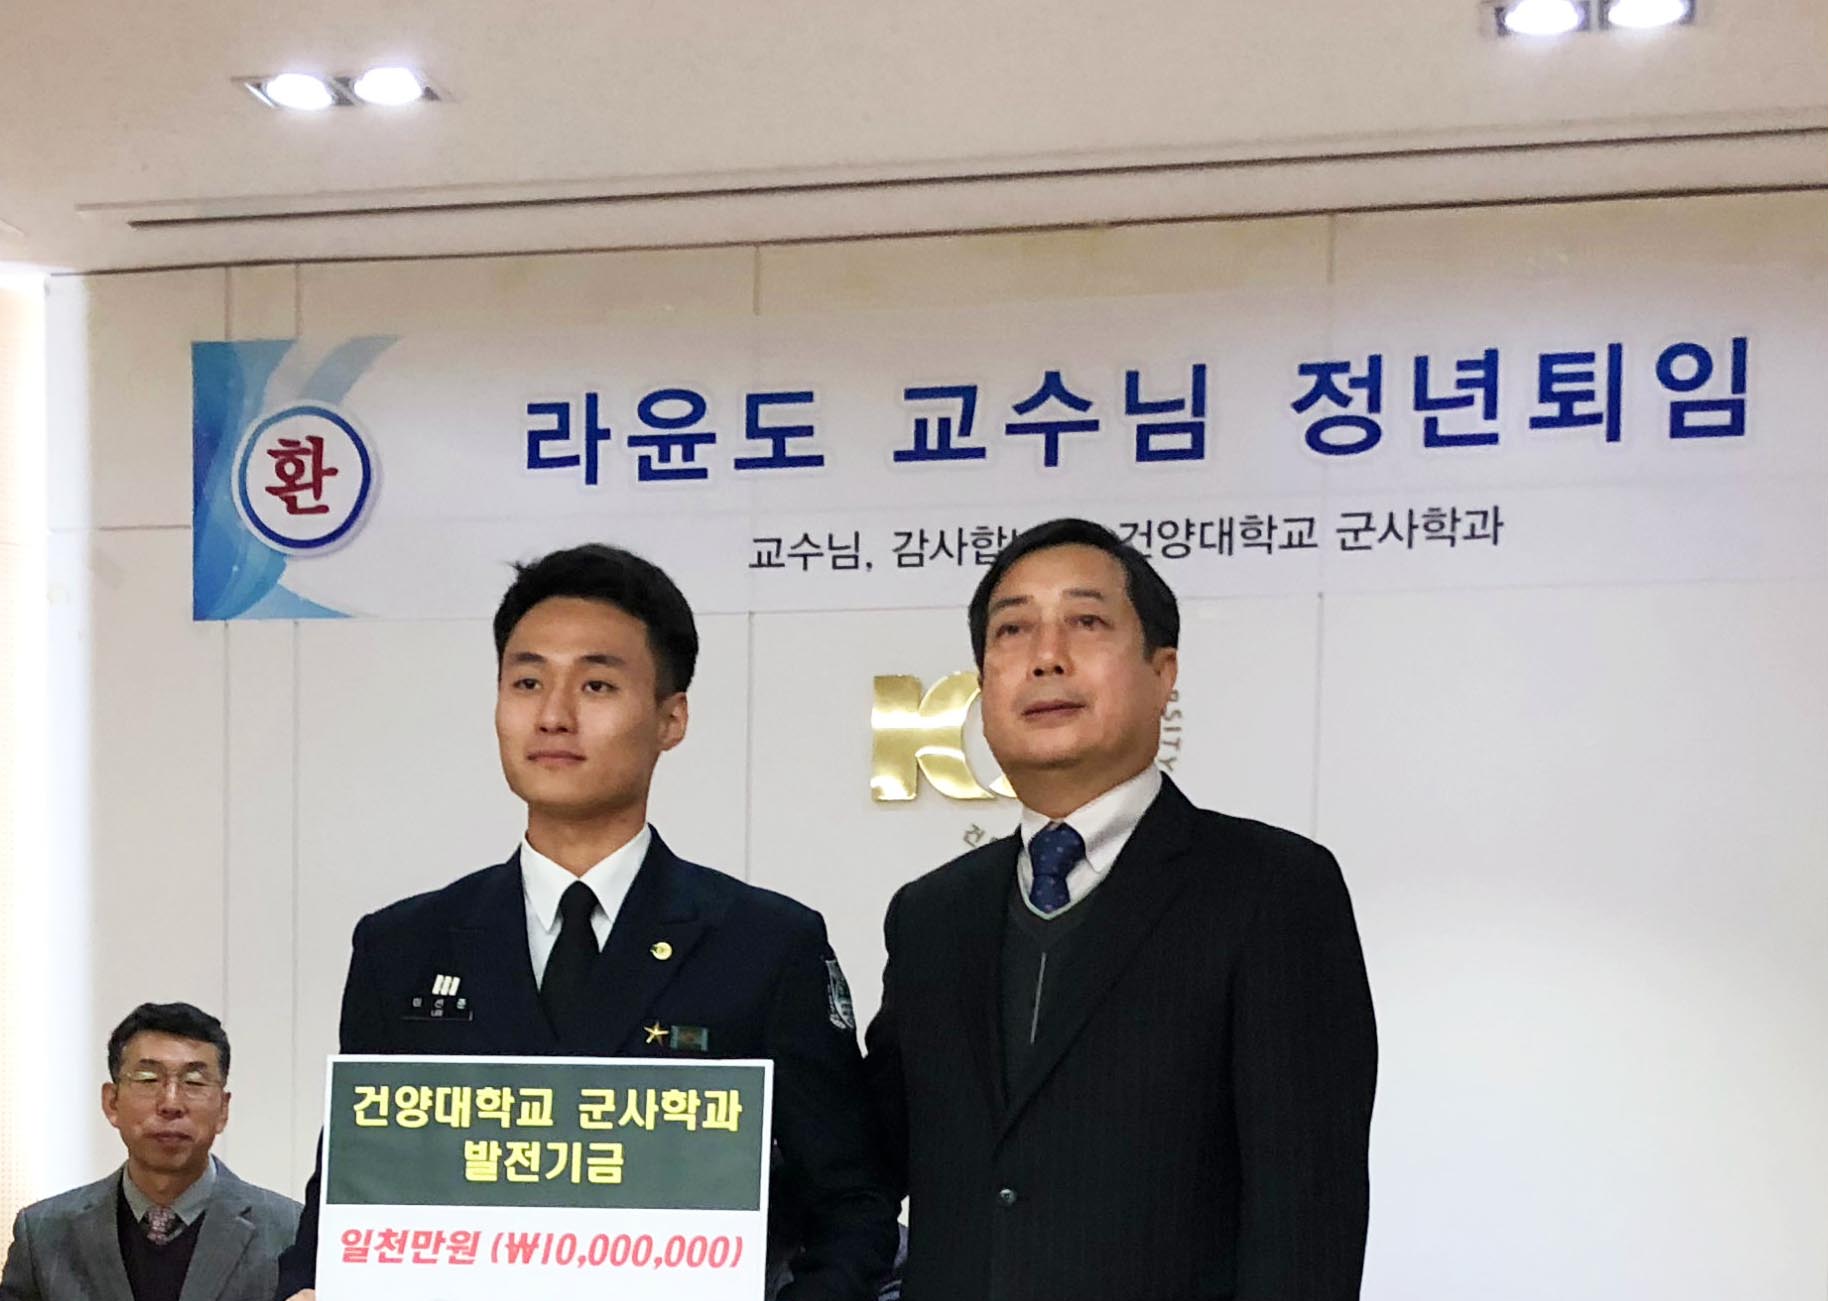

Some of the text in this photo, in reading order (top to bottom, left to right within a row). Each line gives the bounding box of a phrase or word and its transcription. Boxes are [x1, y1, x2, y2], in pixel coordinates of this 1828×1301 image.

[526, 336, 1749, 485] 라윤도 교수님 정년퇴임
[265, 435, 338, 515] 환
[749, 505, 1504, 572] 교수님, 감사합 건양대학교 군사학과
[352, 1085, 743, 1132] 건양대학교 군사학과
[463, 1140, 625, 1184] 발전기금
[340, 1228, 743, 1268] 일천만원 (₩10,000,000)
